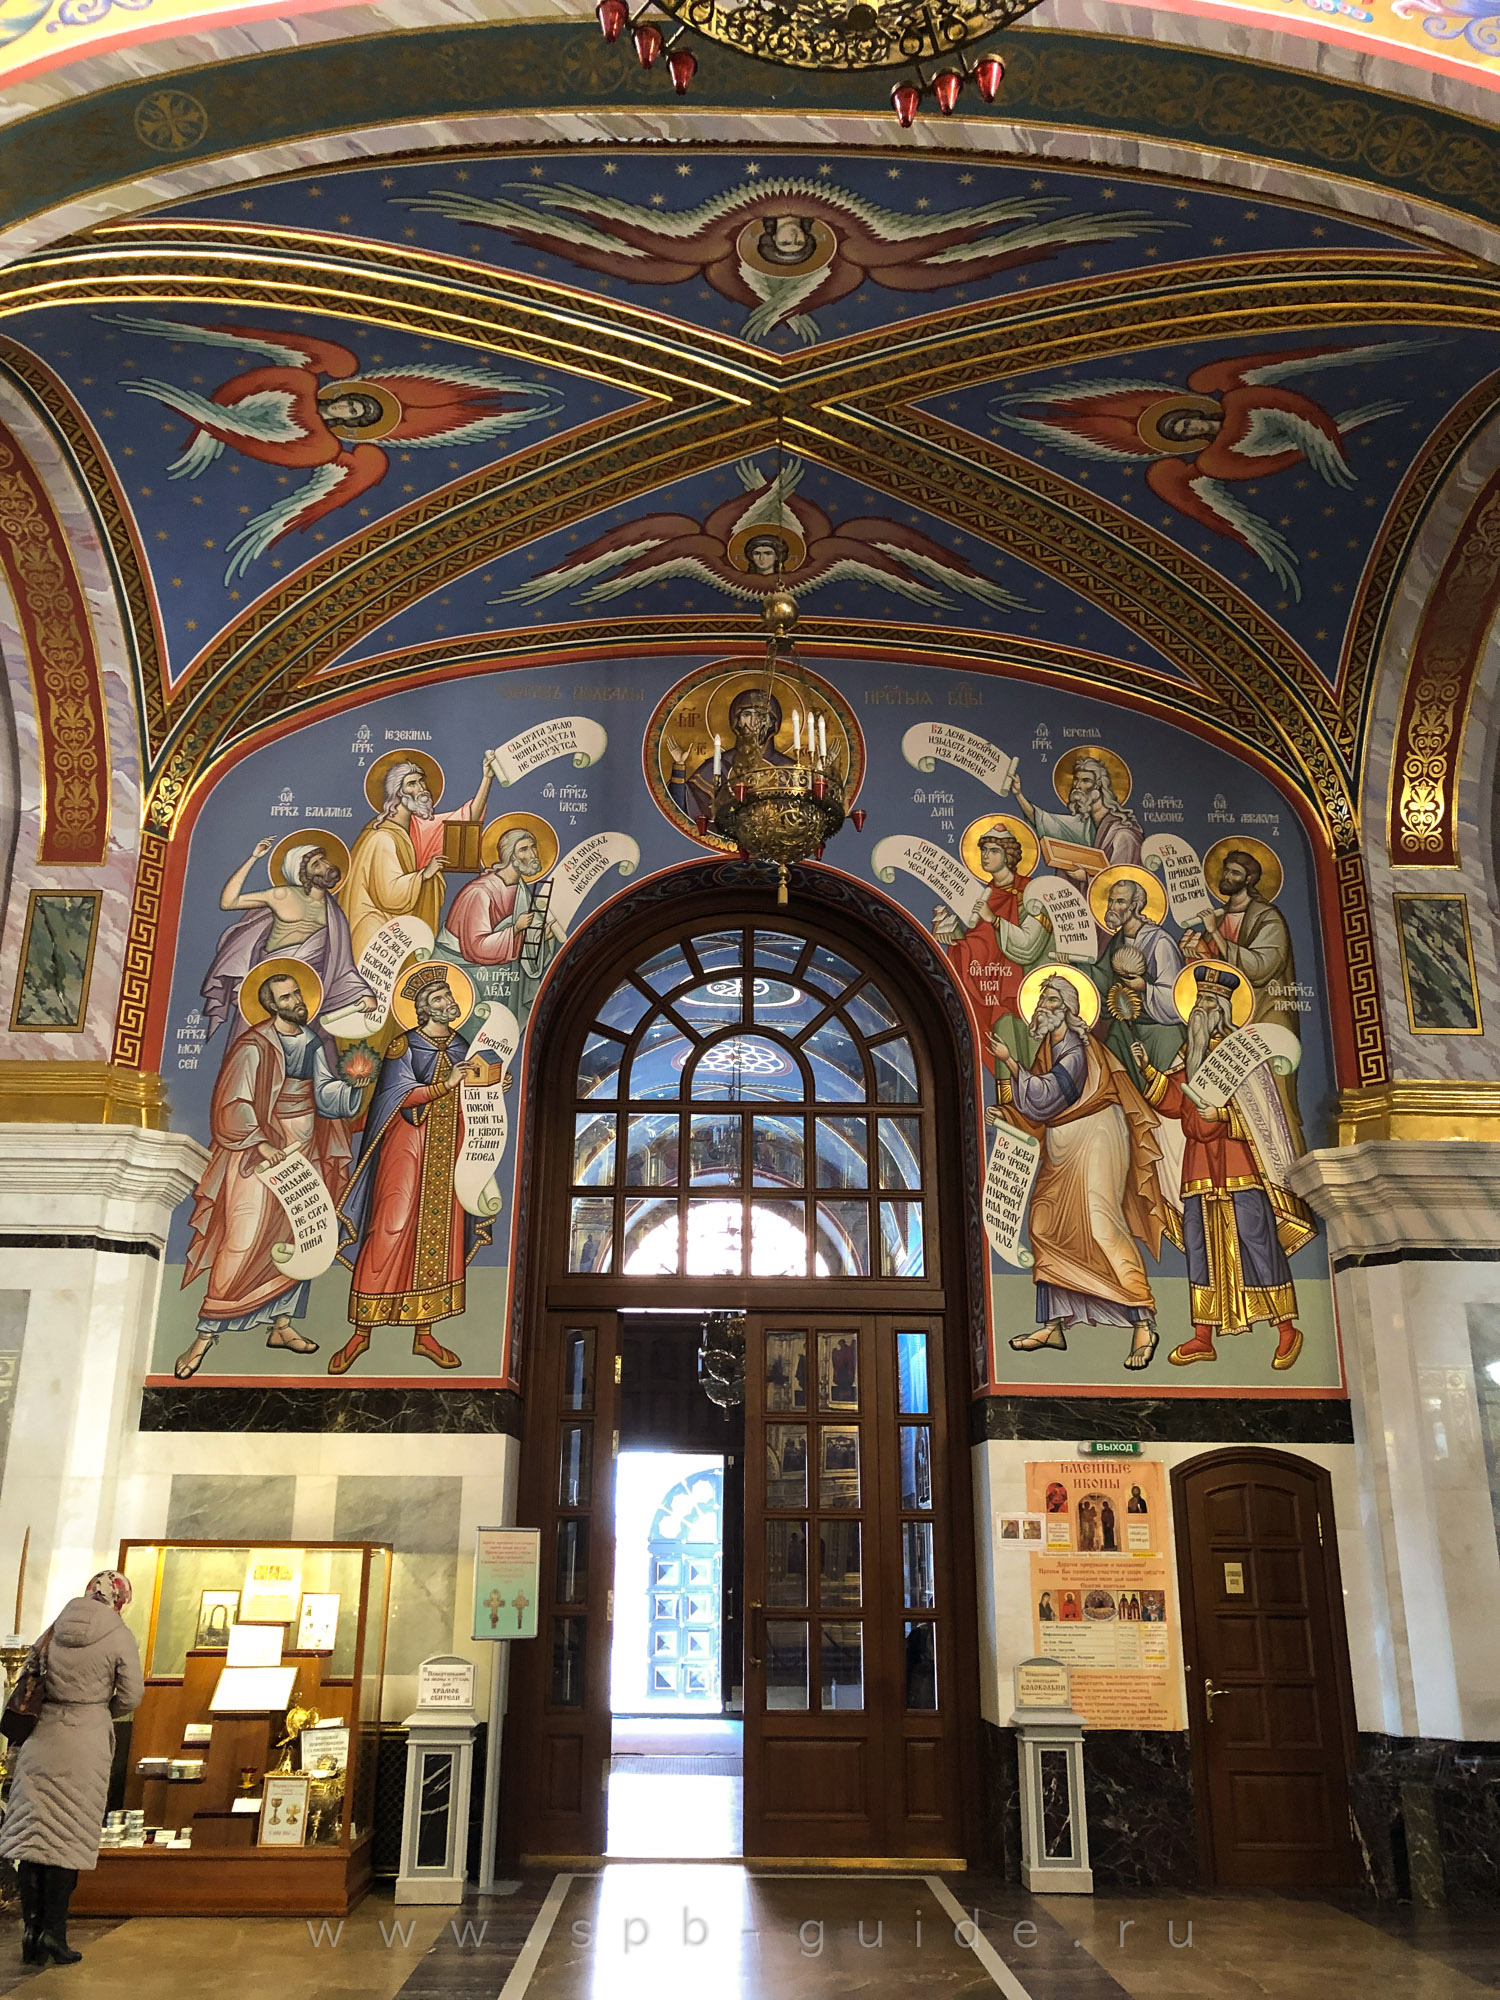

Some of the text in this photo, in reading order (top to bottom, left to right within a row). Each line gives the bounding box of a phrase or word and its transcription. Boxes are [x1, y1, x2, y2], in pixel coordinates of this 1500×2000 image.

[1096, 1443, 1134, 1453] ВЫХОД
[1060, 1463, 1132, 1474] ИМЕННЫЕ
[1073, 1478, 1121, 1489] ИКОНЫ
